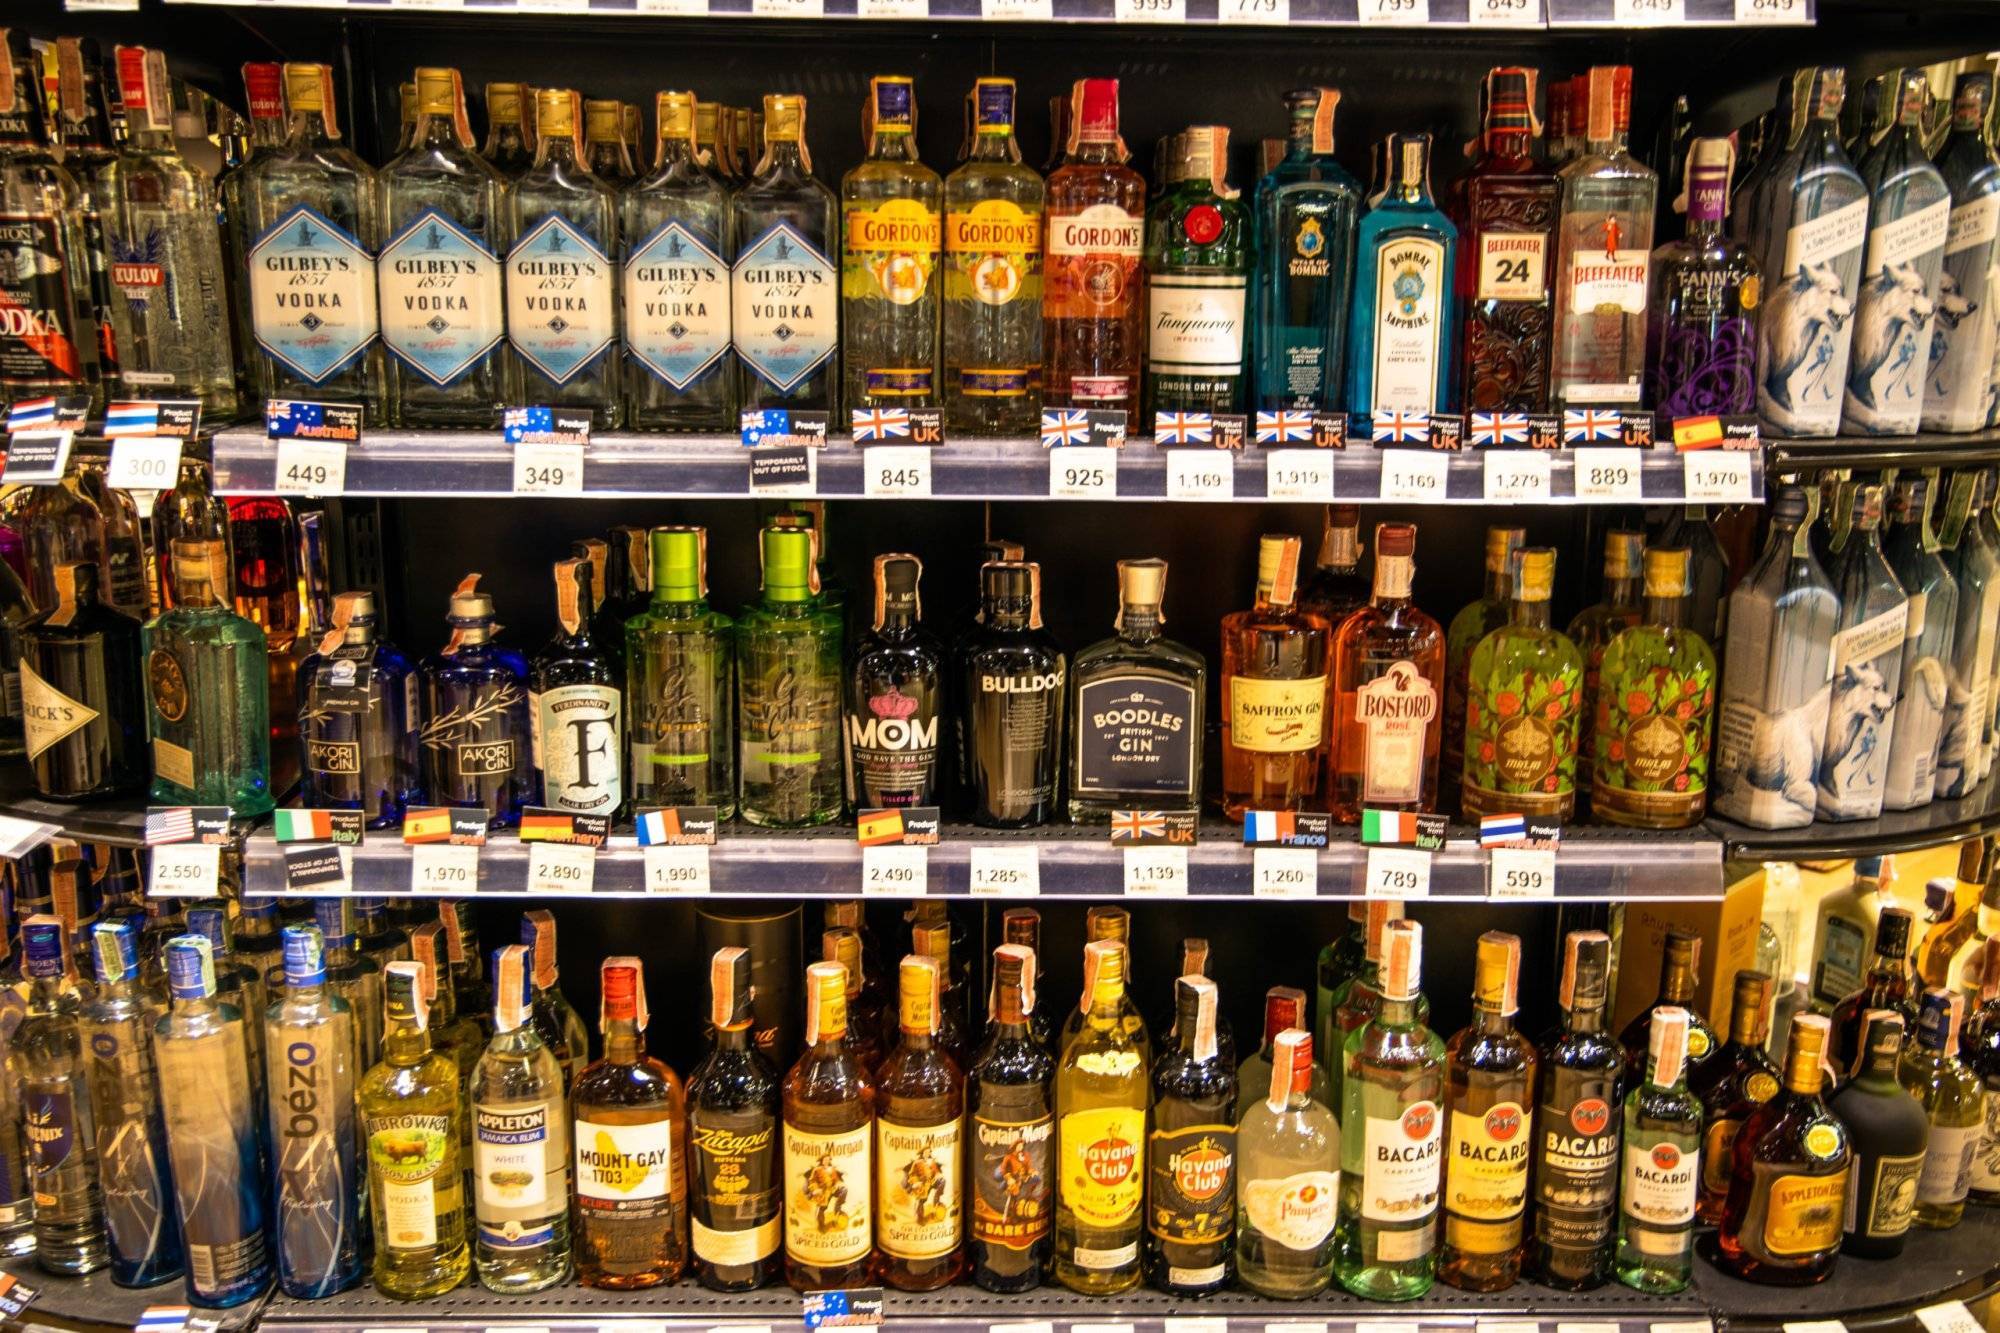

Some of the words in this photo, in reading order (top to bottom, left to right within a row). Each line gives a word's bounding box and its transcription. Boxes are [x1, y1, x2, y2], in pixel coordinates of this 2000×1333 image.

[864, 220, 937, 244] GORDON'S
[959, 222, 1034, 244] GORDON'S
[1065, 224, 1140, 247] GORDON'S
[1486, 239, 1540, 255] BEEFEATER
[266, 256, 349, 272] GILBEY'S
[395, 260, 477, 275] GILBEY'S
[1390, 250, 1432, 270] BOMBAY
[116, 266, 160, 284] KULOV
[518, 261, 596, 277] GILBEY'S
[636, 266, 716, 282] GILBEY'S
[744, 268, 824, 284] GILBEY'S
[1290, 264, 1329, 276] BOMBAY
[1494, 258, 1530, 283] 24
[1574, 264, 1644, 286] BEEFEATER
[288, 272, 330, 286] 1857
[416, 274, 458, 289] 1857
[538, 278, 576, 291] 1857
[1676, 270, 1740, 288] TANN'S
[657, 282, 696, 296] 1857
[764, 284, 804, 299] 1857
[276, 292, 342, 308] VODKA
[404, 296, 469, 310] VODKA
[526, 296, 587, 312] VODKA
[646, 302, 707, 318] VODKA
[752, 304, 813, 319] VODKA
[1156, 311, 1236, 334] Tanqueray
[1384, 310, 1431, 329] SAPPHIRE
[1158, 381, 1192, 392] LONDON
[1194, 382, 1212, 392] DRY
[1214, 382, 1229, 392] GIN
[327, 409, 358, 419] Product
[909, 412, 940, 422] Product
[1621, 416, 1650, 425] Product
[294, 422, 358, 440] Australia
[558, 418, 590, 430] Product
[794, 420, 826, 431] Product
[1094, 422, 1126, 433] Product
[1212, 420, 1242, 429] Product
[1312, 418, 1342, 428] Product
[1430, 420, 1460, 430] Product
[1528, 419, 1558, 428] Product
[1727, 424, 1758, 434] Product
[913, 426, 941, 442] UK
[1215, 434, 1242, 450] UK
[1315, 432, 1342, 448] UK
[1432, 434, 1459, 450] UK
[1532, 433, 1558, 449] UK
[1624, 430, 1651, 446] UK
[128, 459, 166, 476] 300
[753, 466, 771, 476] OUT
[772, 465, 782, 474] OF
[782, 464, 808, 474] STOCK
[754, 456, 804, 468] TEMPORARILY
[287, 464, 327, 484] 449
[524, 466, 564, 486] 349
[880, 468, 920, 487] 845
[1065, 468, 1104, 487] 925
[1178, 474, 1222, 490] 1,169
[1276, 470, 1319, 487] 1,919
[1392, 473, 1436, 490] 1,169
[1497, 473, 1539, 490] 1,279
[1590, 468, 1628, 485] 889
[1694, 471, 1738, 487] 1,970
[1242, 702, 1302, 716] SAFFRON
[1364, 694, 1431, 718] BOSFORD
[1093, 708, 1184, 732] BOODLES
[851, 714, 938, 751] MOM
[1120, 727, 1153, 736] BRITISH
[310, 744, 353, 758] AKORI
[566, 712, 617, 789] F
[1119, 738, 1153, 752] GIN
[462, 747, 508, 762] AKORI
[1111, 754, 1144, 762] LONDON
[1145, 754, 1161, 762] DRY
[328, 758, 354, 771] GIN
[485, 758, 510, 770] GIN
[331, 815, 360, 824] Product
[576, 816, 606, 825] Product
[684, 820, 714, 830] Product
[908, 820, 938, 830] Product
[1166, 815, 1195, 825] Product
[1298, 818, 1327, 827] Product
[1416, 819, 1445, 829] Product
[332, 828, 360, 845] Italy
[1168, 829, 1194, 842] UK
[1530, 824, 1560, 834] Product
[545, 830, 606, 848] Germany
[1280, 831, 1327, 848] France
[1416, 834, 1444, 850] Italy
[160, 864, 202, 880] 2,550
[424, 866, 466, 881] 1,970
[538, 864, 581, 881] 2,890
[655, 867, 697, 883] 1,990
[870, 868, 913, 883] 2,490
[976, 868, 1018, 886] 1,285
[1132, 865, 1174, 881] 1,139
[1263, 868, 1304, 884] 1,260
[1382, 870, 1418, 889] 789
[1506, 870, 1542, 888] 599
[284, 1042, 319, 1138] bézo
[478, 1112, 544, 1132] APPLETON
[480, 1131, 518, 1144] JAMAICA
[519, 1130, 542, 1142] RUM
[884, 1131, 922, 1152] Captain
[979, 1124, 1019, 1146] Captain
[788, 1134, 820, 1156] Captain
[825, 1136, 864, 1157] Morgan
[1078, 1142, 1138, 1162] Havana
[580, 1149, 631, 1169] MOUNT
[636, 1149, 666, 1168] GAY
[1168, 1153, 1232, 1174] Havana
[592, 1169, 623, 1184] 1703
[1089, 1160, 1128, 1180] Club
[1183, 1172, 1221, 1192] Club
[1106, 1192, 1116, 1206] 3
[985, 1222, 1024, 1236] DARK
[1194, 1212, 1210, 1232] 7
